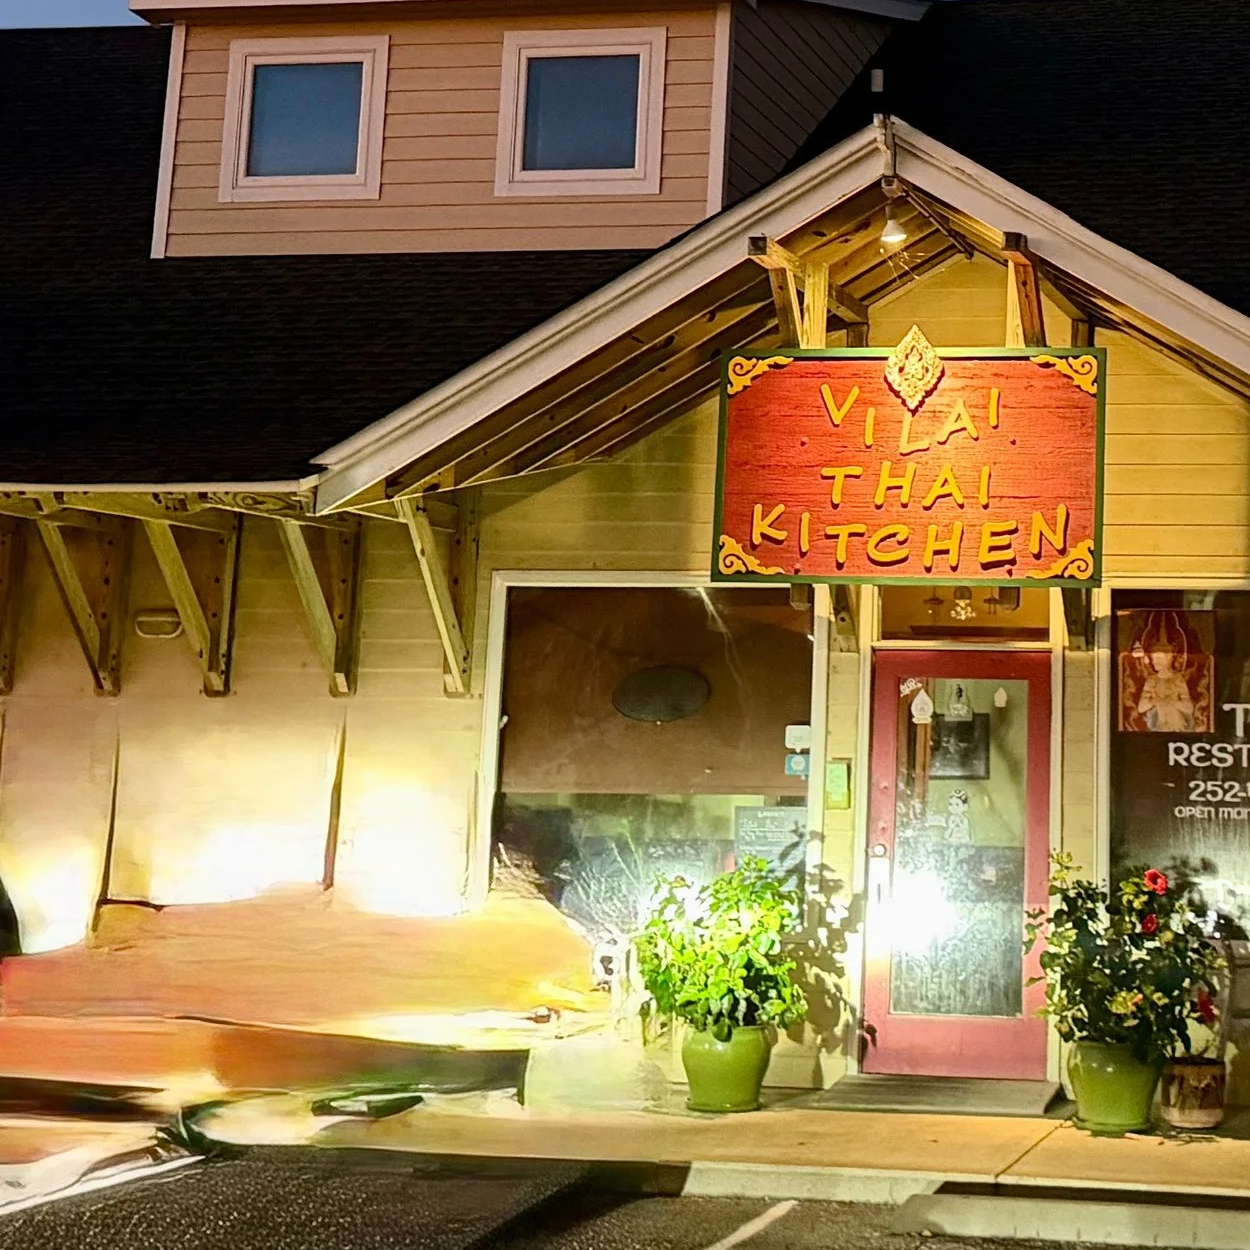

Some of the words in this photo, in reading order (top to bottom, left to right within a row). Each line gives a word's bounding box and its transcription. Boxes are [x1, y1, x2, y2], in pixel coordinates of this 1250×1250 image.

[820, 383, 1000, 454] VILAI
[820, 461, 991, 508] THAI
[751, 503, 1068, 569] KITCHEN
[1174, 806, 1215, 819] OPEN
